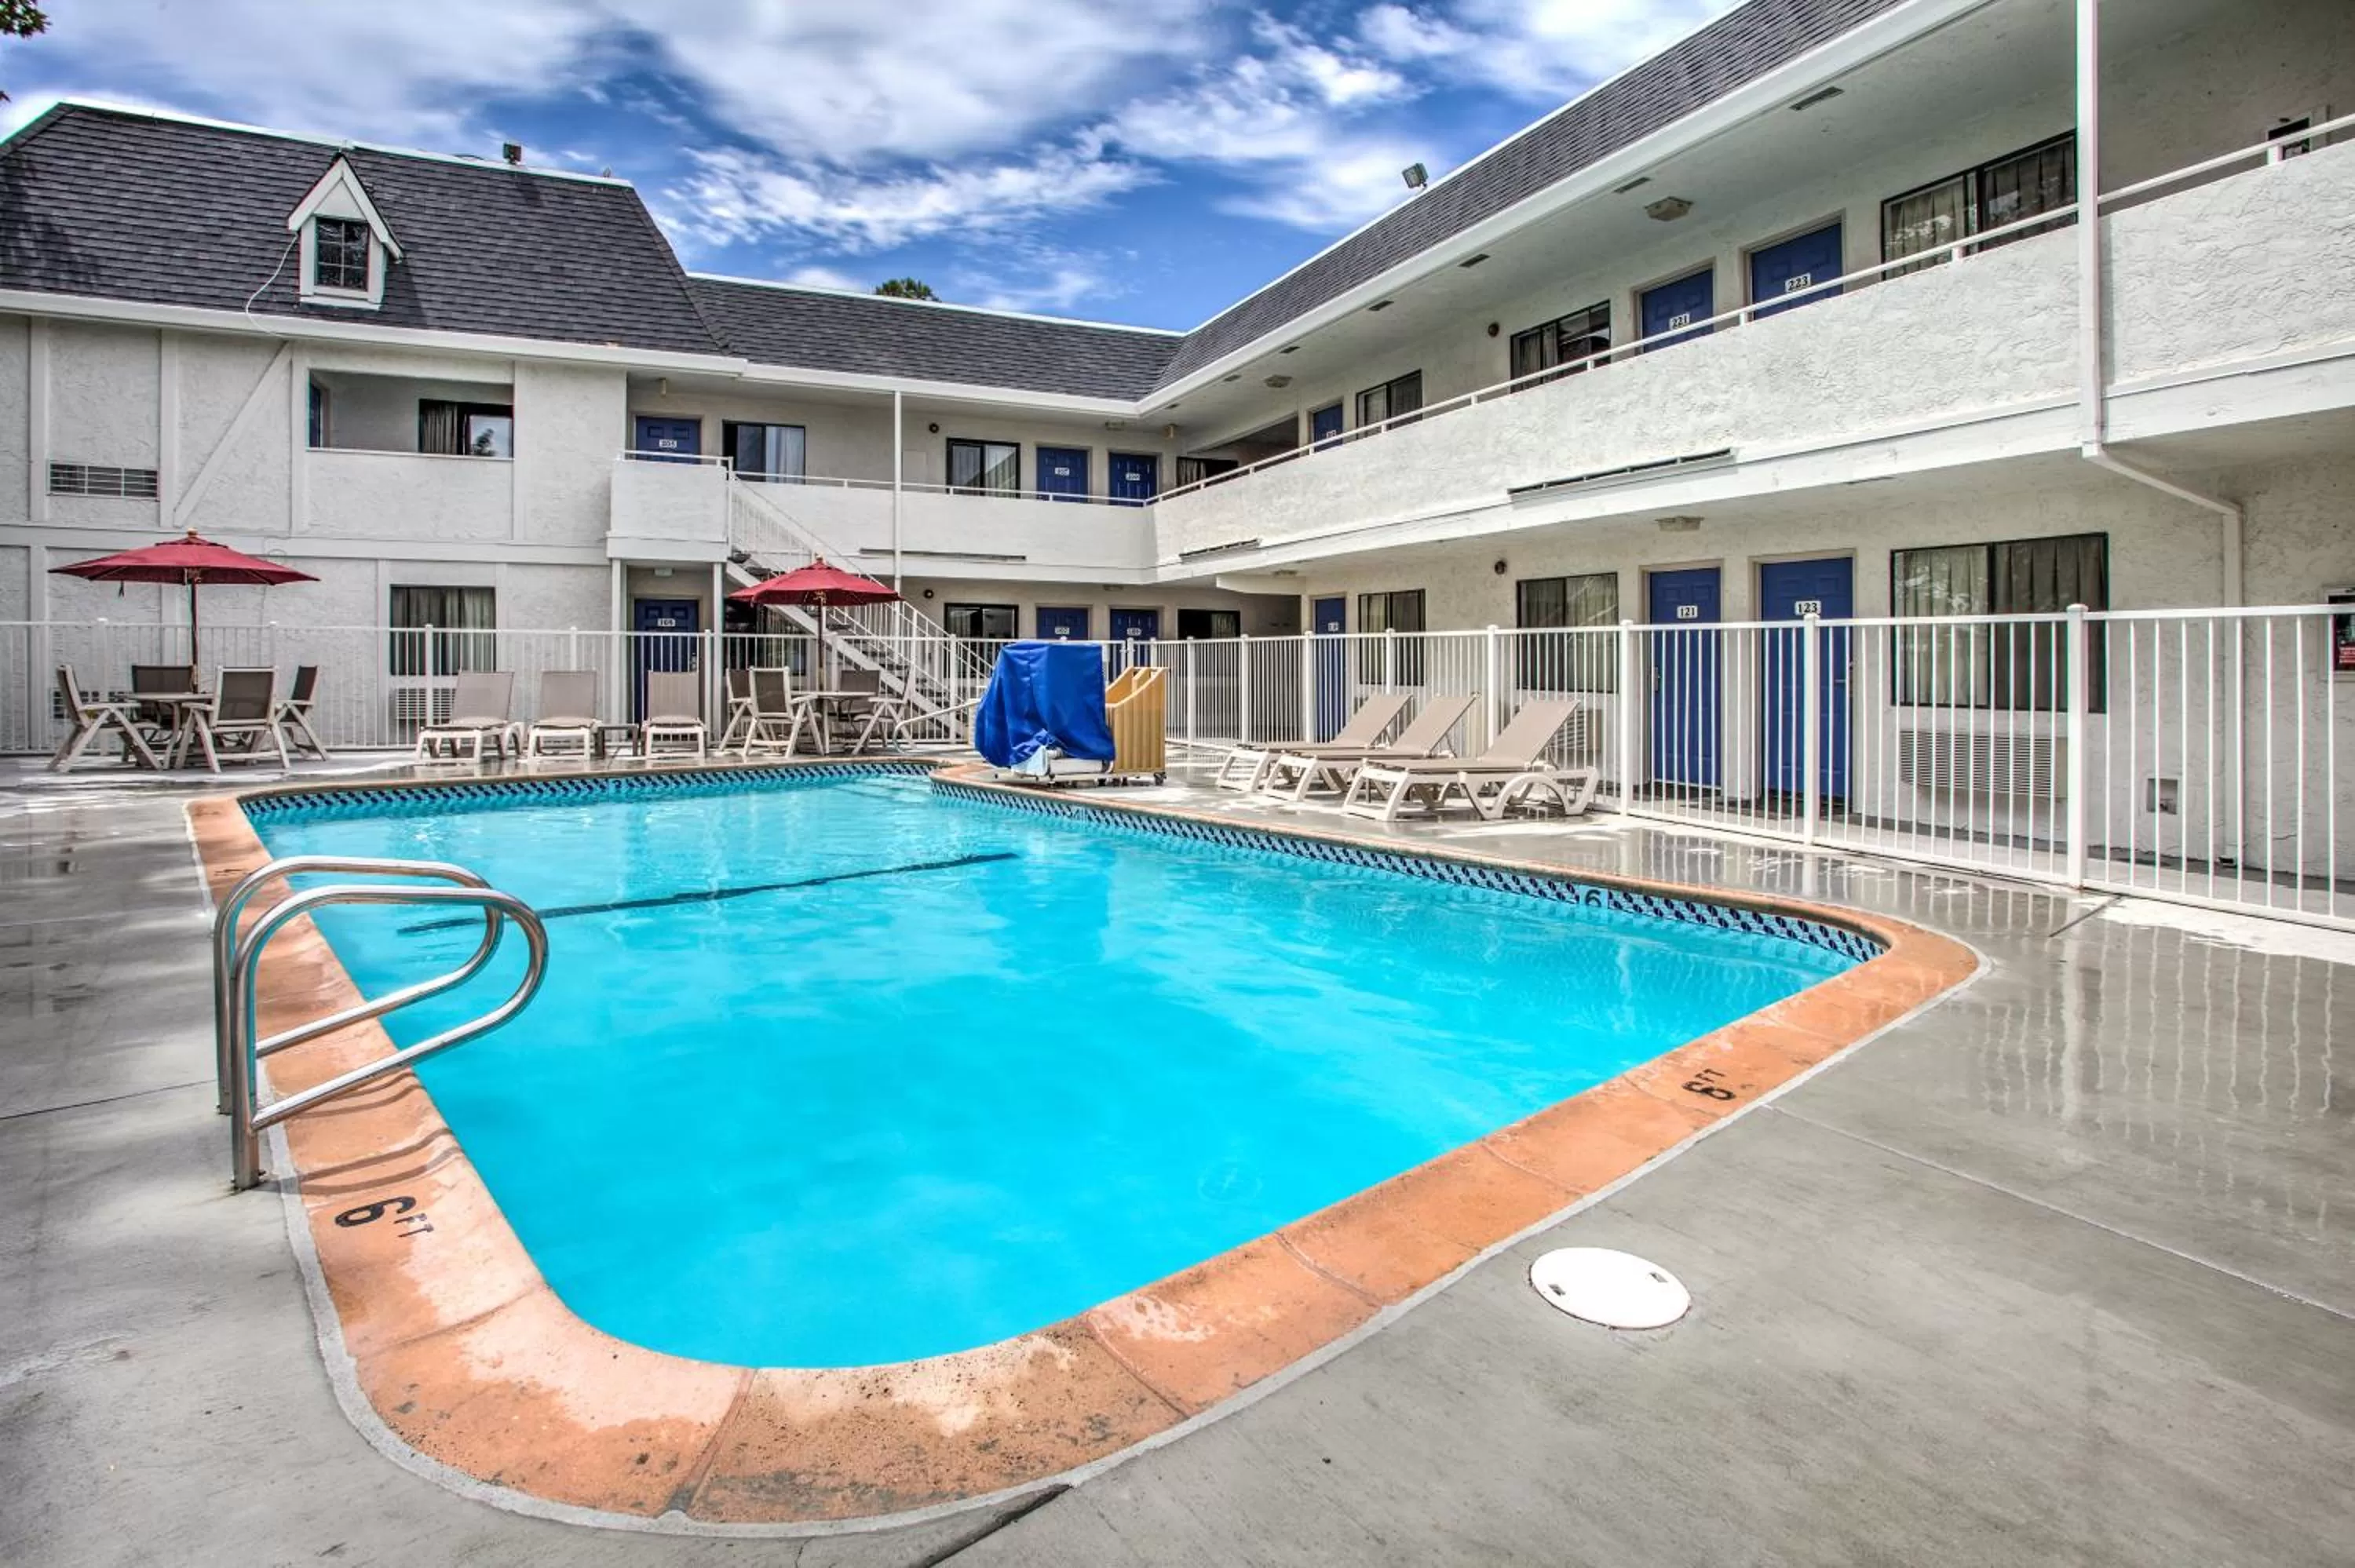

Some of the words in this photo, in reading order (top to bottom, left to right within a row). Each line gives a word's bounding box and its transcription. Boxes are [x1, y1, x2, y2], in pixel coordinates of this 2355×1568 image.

[1788, 275, 1808, 290] 223
[1672, 315, 1688, 328] 221
[1681, 607, 1695, 617] 121
[1798, 602, 1817, 613] 123
[1586, 889, 1601, 908] 6
[1681, 1081, 1736, 1100] 6
[335, 1197, 416, 1227] 6
